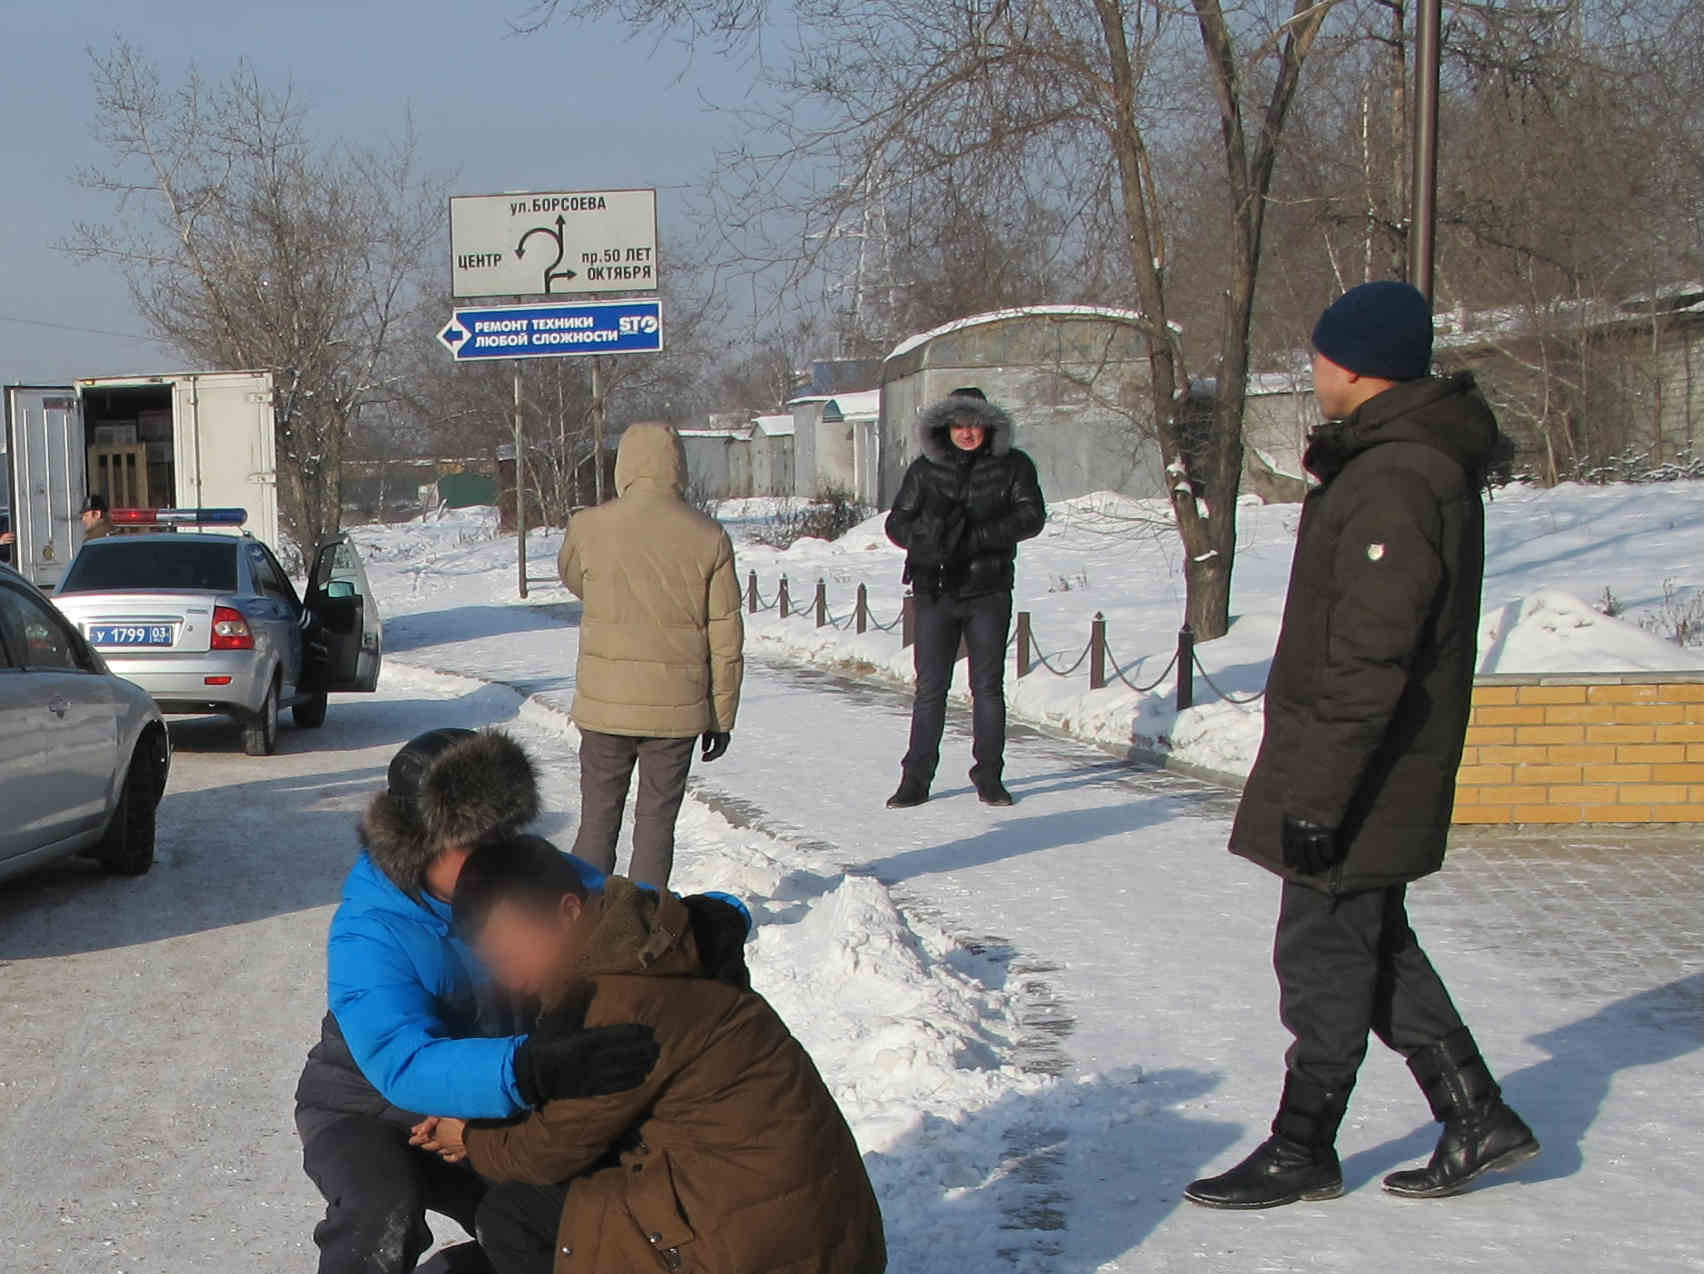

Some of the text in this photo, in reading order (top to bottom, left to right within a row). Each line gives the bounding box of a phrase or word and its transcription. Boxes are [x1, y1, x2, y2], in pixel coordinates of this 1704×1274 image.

[510, 196, 607, 216] ул.БОРСОЕВА
[458, 253, 502, 270] ЦЕНТР
[581, 247, 652, 265] пр.50 ЛЕТ
[587, 265, 652, 281] ОКТЯБРЯ
[474, 316, 594, 333] РЕМОНТ ТЕХНИКИ
[474, 330, 619, 348] ЛЮБОЙ СЛОЖНОСТИ
[111, 628, 145, 642] 1799
[151, 627, 166, 638] 03
